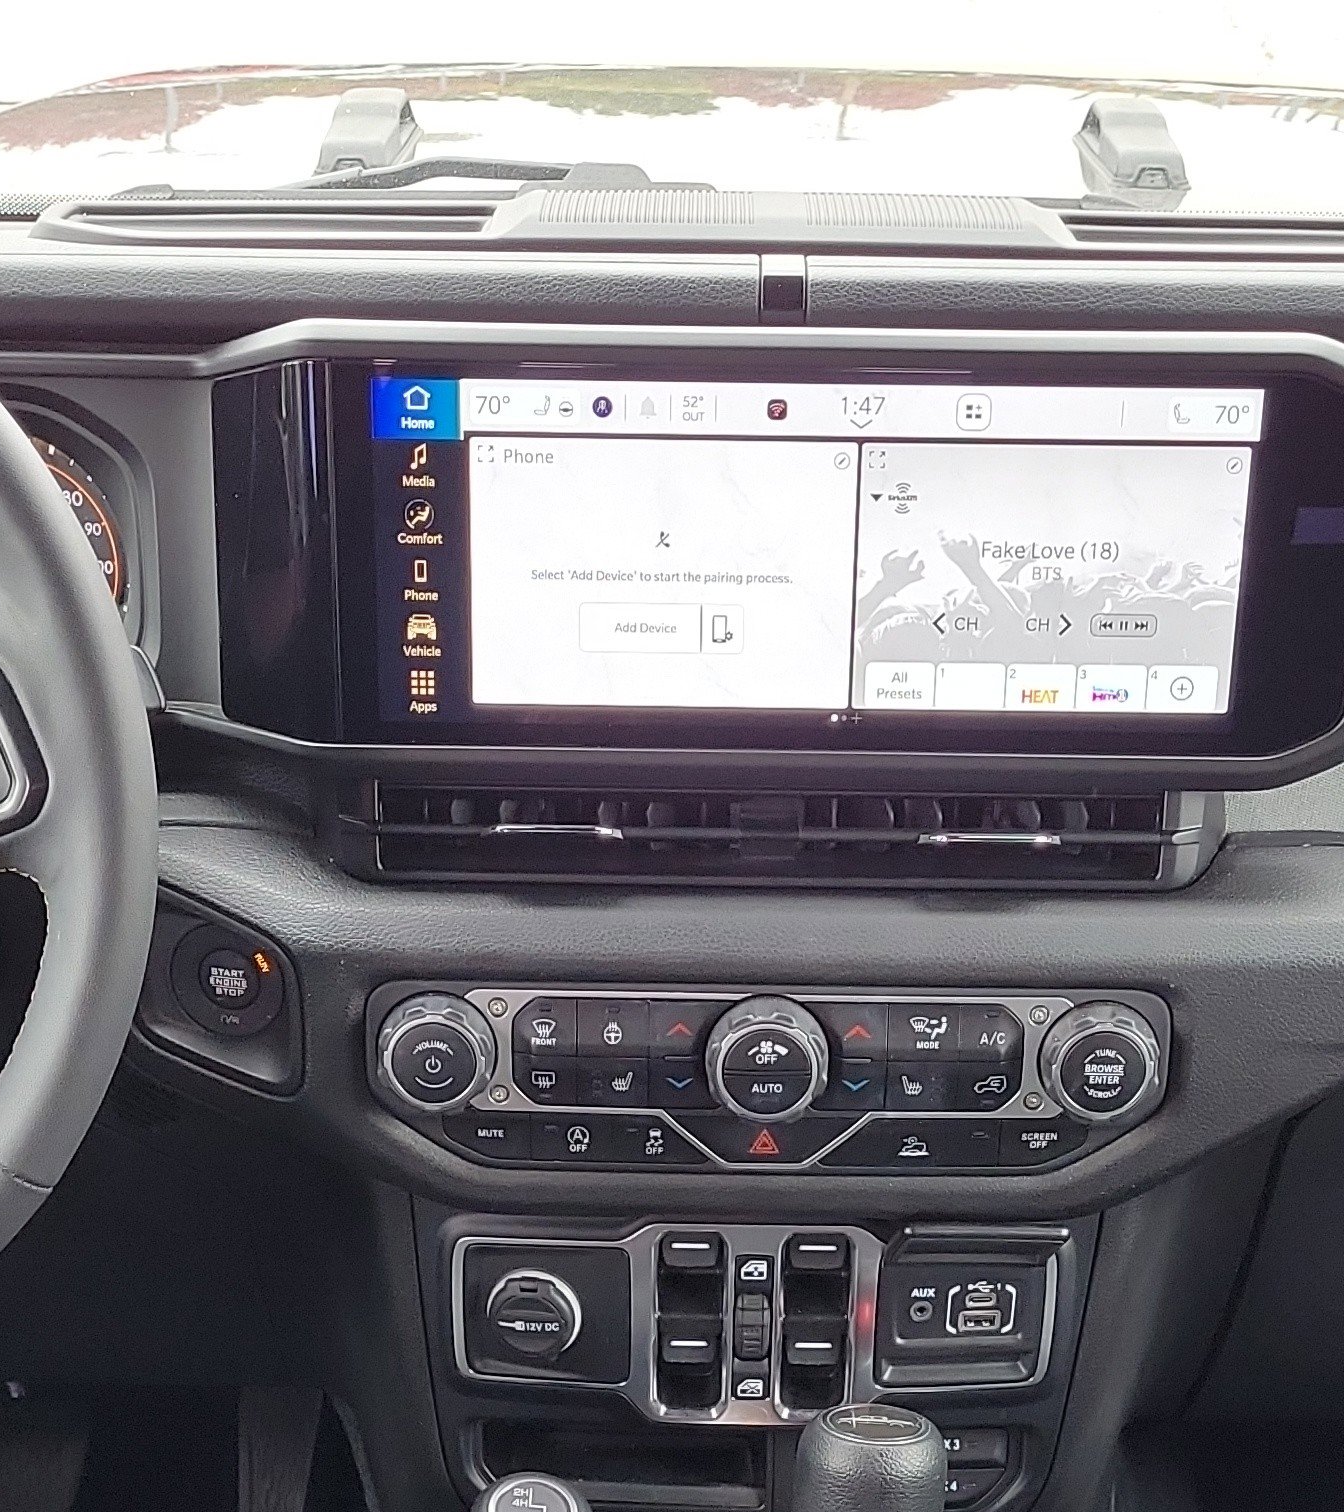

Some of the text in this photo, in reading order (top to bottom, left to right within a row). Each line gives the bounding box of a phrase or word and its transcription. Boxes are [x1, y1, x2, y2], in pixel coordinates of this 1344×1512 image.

[841, 396, 886, 416] 1:47
[682, 410, 705, 423] OUT
[401, 416, 435, 430] Home
[503, 449, 554, 465] Phone
[402, 475, 435, 488] Media
[84, 522, 102, 536] 90
[397, 532, 443, 546] Comfort
[980, 541, 1120, 564] Fake Love (18)
[531, 568, 794, 587] Select 'Add Device' to start the pairing process.
[1032, 566, 1062, 582] BTS
[404, 588, 439, 602] Phone
[614, 621, 677, 634] Add Device
[954, 616, 979, 632] CH
[1025, 617, 1050, 633] CH
[403, 644, 441, 658] Vehicle
[891, 671, 908, 684] All
[1009, 669, 1017, 679] 2
[1080, 670, 1087, 680] 3
[1150, 670, 1158, 680] 4
[876, 686, 923, 701] Presets
[1021, 689, 1059, 704] HEAT
[409, 701, 437, 714] Apps
[254, 953, 270, 973] RUN
[210, 967, 244, 978] START
[209, 976, 248, 988] ENGINE
[215, 987, 245, 997] STOP
[531, 1037, 556, 1046] FRONT
[979, 1031, 1006, 1046] A/C
[415, 1040, 450, 1052] VOLUME
[916, 1041, 939, 1049] MODE
[755, 1054, 778, 1065] OFF
[1095, 1049, 1116, 1058] TUNE
[1084, 1063, 1124, 1073] BROWSE
[1089, 1074, 1119, 1084] ENTER
[751, 1082, 783, 1095] AUTO
[1087, 1088, 1118, 1098] SCROLL
[477, 1128, 504, 1138] MUTE
[1021, 1132, 1058, 1141] SCREEN
[569, 1143, 588, 1152] OFF
[645, 1146, 664, 1155] OFF
[1029, 1140, 1048, 1149] OFF
[911, 1288, 936, 1298] AUX
[513, 1488, 529, 1497] 2H
[512, 1498, 529, 1507] 4H
